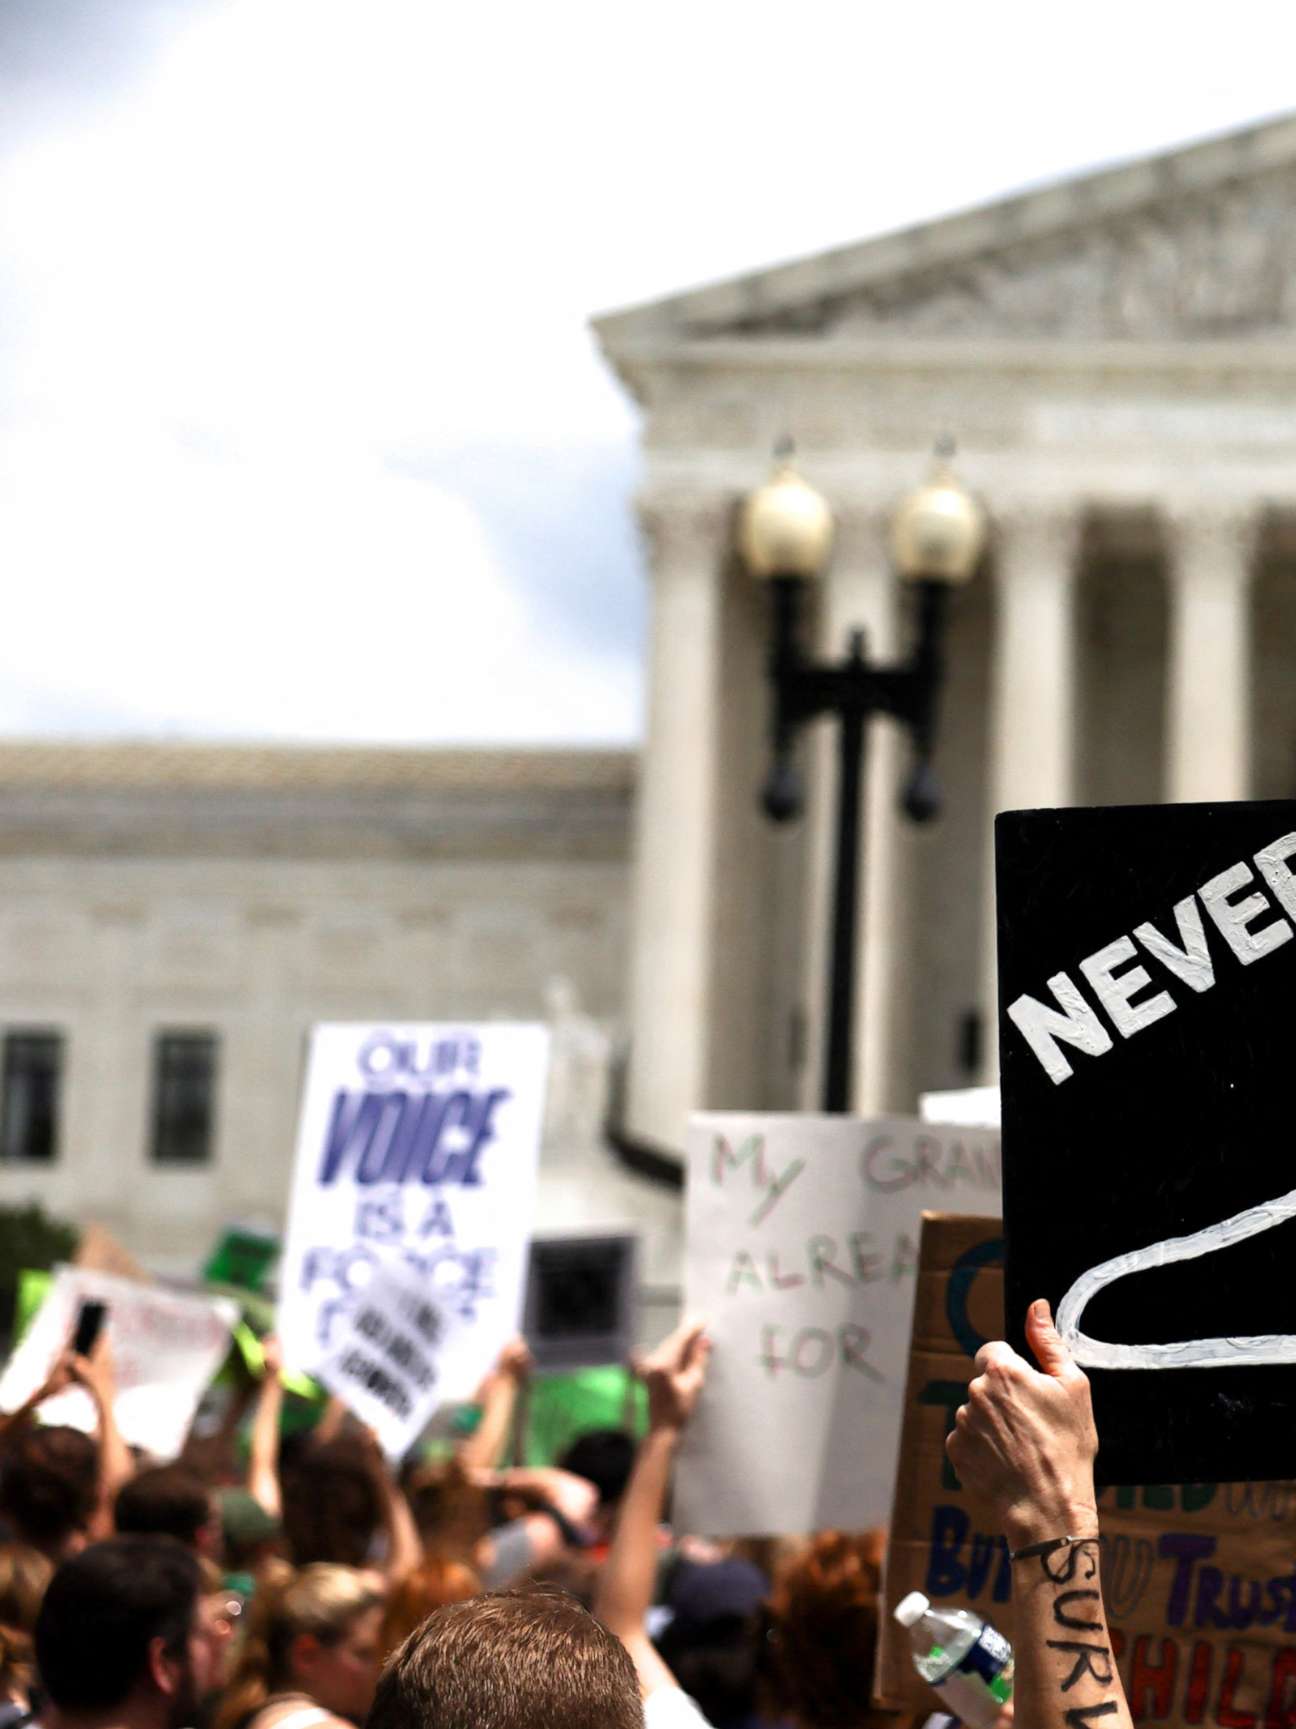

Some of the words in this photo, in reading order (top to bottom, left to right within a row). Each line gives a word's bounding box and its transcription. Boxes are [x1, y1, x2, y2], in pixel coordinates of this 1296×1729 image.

[357, 1030, 483, 1080] OUR
[318, 1088, 512, 1186] VOICE
[356, 1197, 404, 1240] IS
[417, 1199, 455, 1238] A
[758, 1324, 886, 1381] FOR
